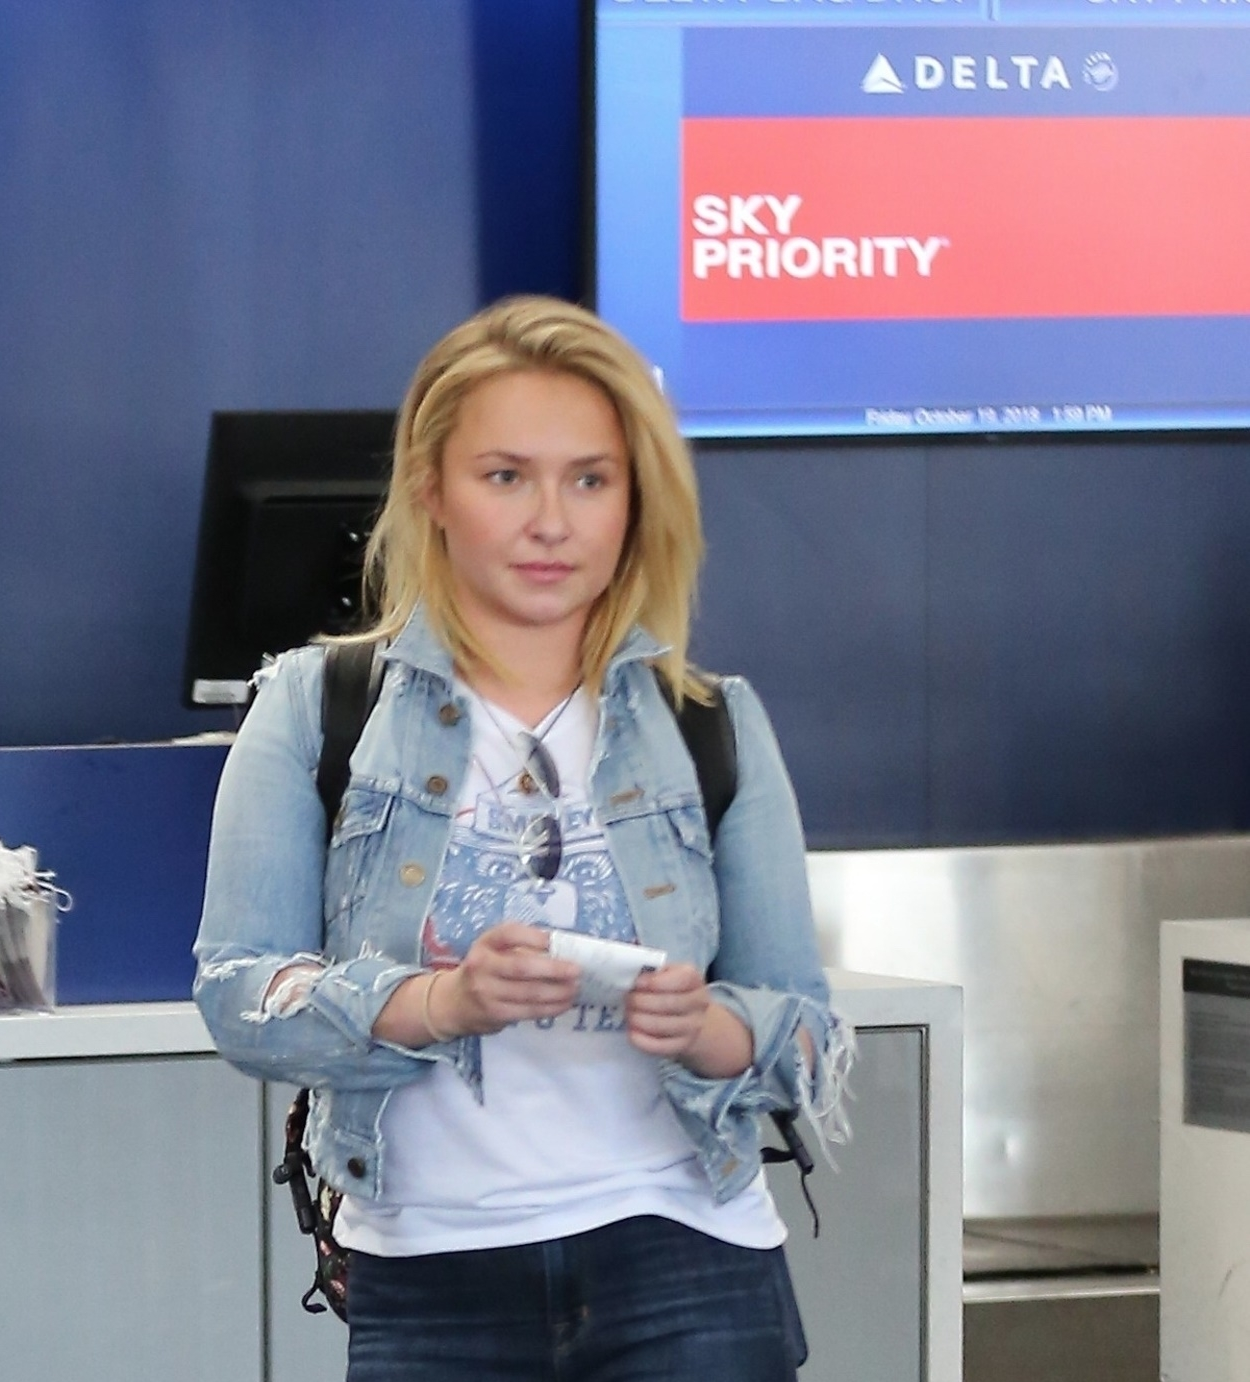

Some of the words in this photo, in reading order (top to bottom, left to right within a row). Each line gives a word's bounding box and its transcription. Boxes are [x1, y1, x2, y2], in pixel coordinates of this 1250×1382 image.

[914, 55, 1072, 90] DELTA
[692, 194, 803, 236] SKY
[693, 236, 934, 279] PRIORITY
